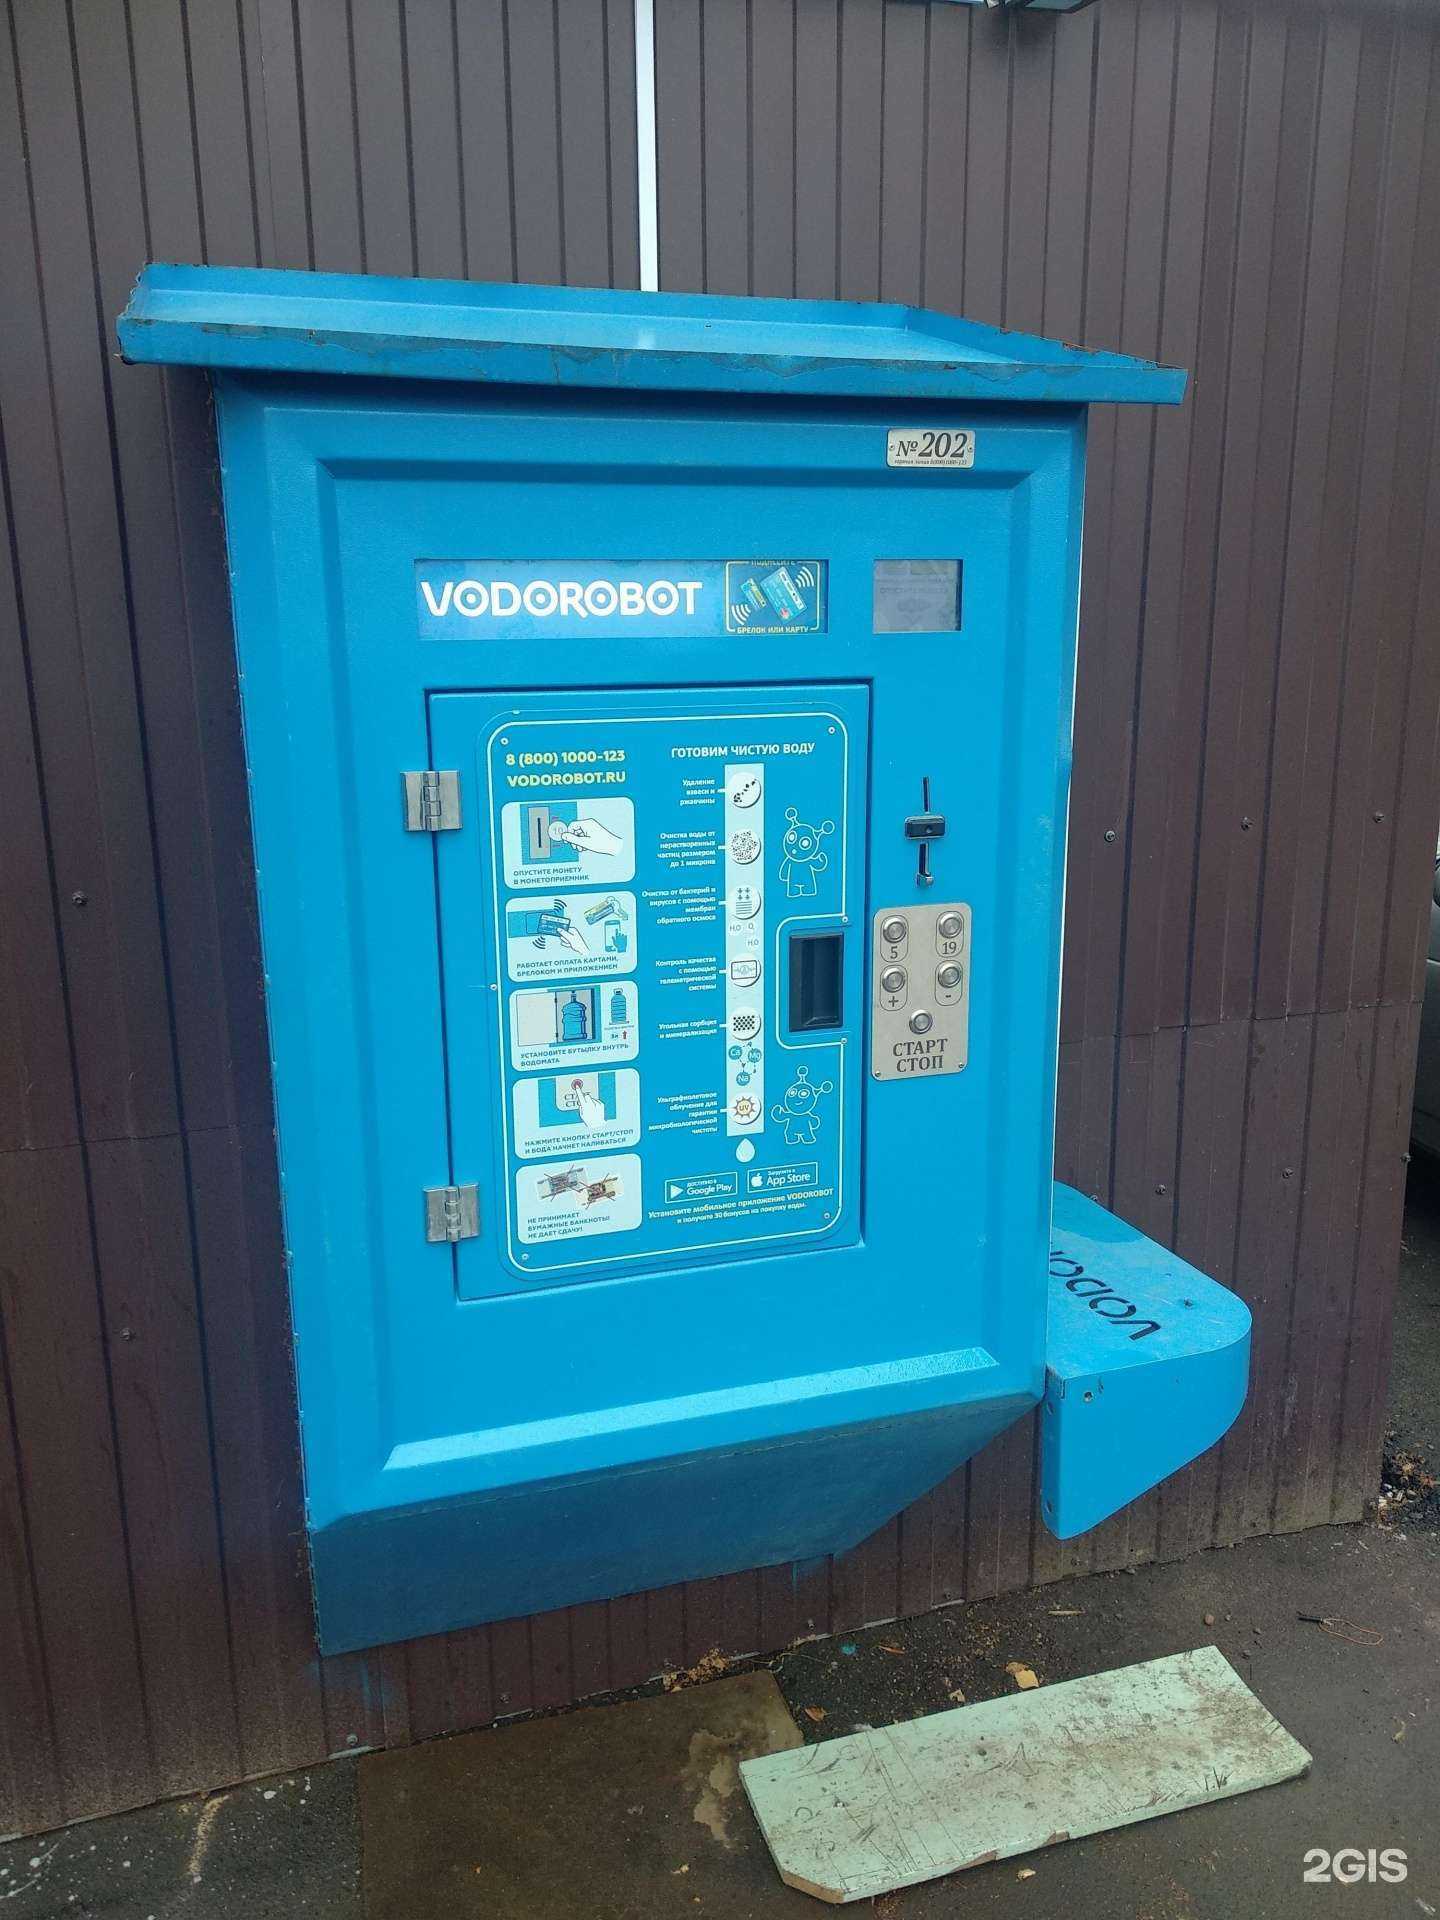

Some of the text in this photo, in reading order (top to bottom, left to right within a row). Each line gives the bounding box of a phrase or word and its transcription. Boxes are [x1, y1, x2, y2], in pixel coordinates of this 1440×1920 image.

[420, 580, 703, 618] VODOROBOT
[671, 743, 815, 758] ГОТОВИМ ЧИСТУЮ ВОДУ
[506, 750, 625, 767] 8 (800) 1000-123
[507, 771, 626, 787] VODOROBOT.RU
[680, 798, 715, 806] ржавчины
[681, 850, 715, 858] размером
[520, 875, 590, 884] МОНЕТОПРИЕМНИК
[679, 887, 710, 895] бактерий
[657, 916, 691, 924] обратного
[890, 946, 898, 959] 5
[942, 942, 957, 955] 19
[516, 961, 552, 969] РАБОТАЕТ
[554, 958, 582, 966] ОПЛАТА
[655, 959, 687, 967] Контроль
[517, 968, 555, 977] БРЕЛОКОМ
[563, 964, 618, 973] ПРИЛОЖЕНИЕМ
[520, 1043, 629, 1059] УСТАНОВИТЕ БУТЫЛКУ ВНУТРЬ
[730, 1048, 741, 1056] Ca
[892, 1039, 948, 1057] СТАРТ
[520, 1058, 560, 1067] ВОДОМАТА
[896, 1055, 944, 1072] СТОП
[525, 1137, 560, 1146] НАЖМИТЕ
[562, 1134, 590, 1142] КНОПКУ
[531, 1146, 551, 1154] ВОДА
[552, 1142, 580, 1150] НАЧНЕТ
[581, 1137, 626, 1148] НАЛИВАТЬСЯ
[767, 1173, 811, 1186] App Store
[687, 1184, 732, 1195] Google Play
[648, 1188, 834, 1218] Установите мобильное приложение VODOROBOT
[538, 1212, 580, 1223] ПРИНИМАЕТ
[682, 1214, 713, 1224] получите
[723, 1210, 750, 1218] бонусов
[760, 1204, 786, 1213] покупку
[528, 1222, 568, 1231] БУМАЖНЫЕ
[538, 1230, 556, 1238] ДАЕТ
[1049, 1251, 1161, 1341] VODO
